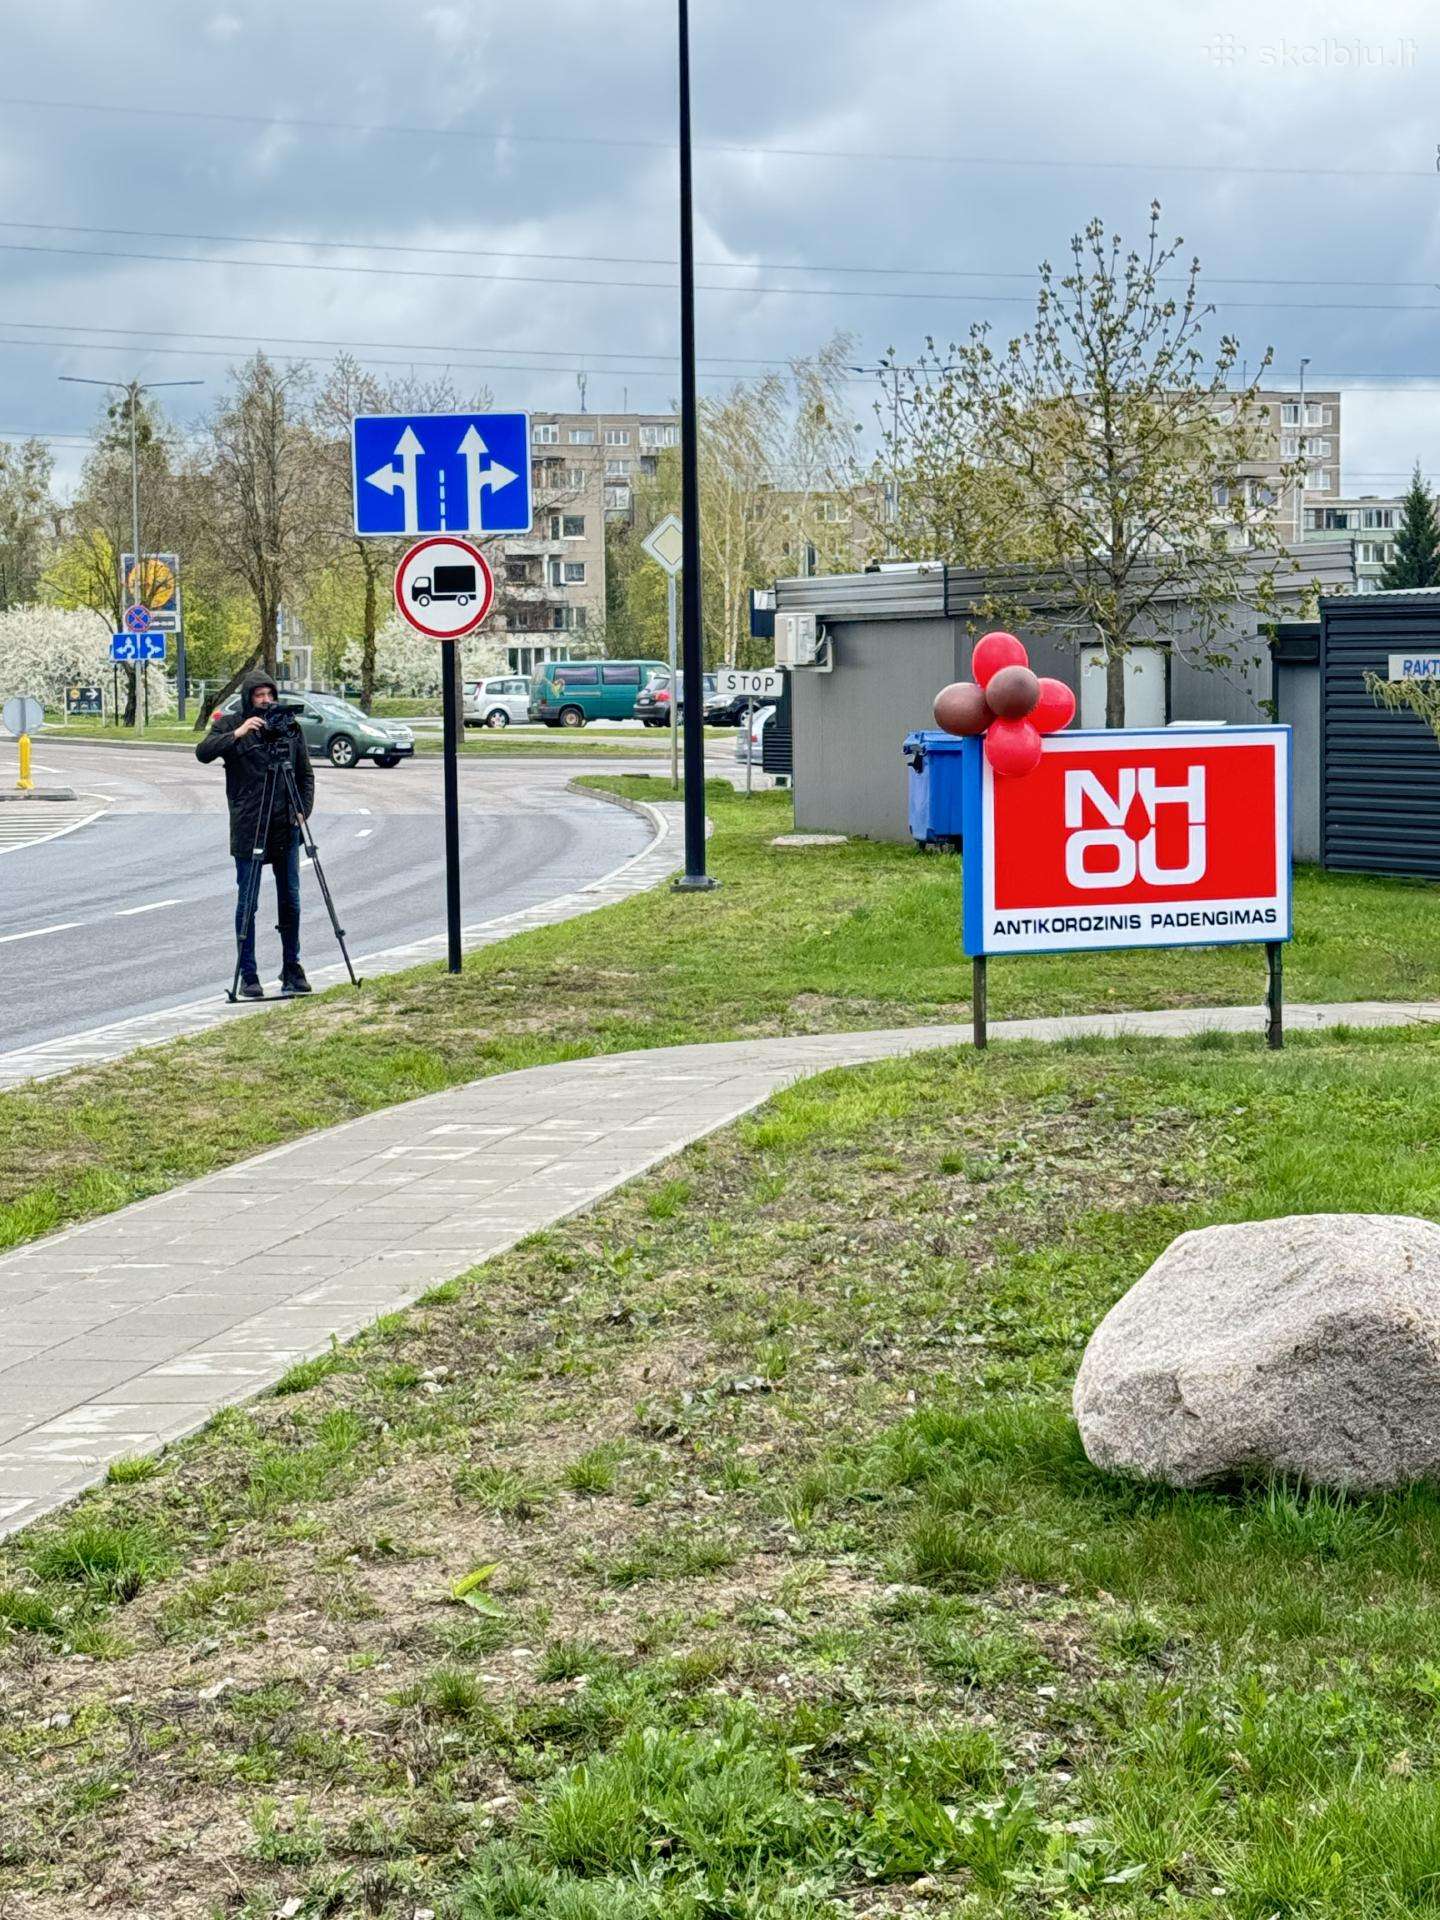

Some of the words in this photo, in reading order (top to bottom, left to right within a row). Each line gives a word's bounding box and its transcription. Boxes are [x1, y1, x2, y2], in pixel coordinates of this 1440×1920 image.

[1402, 659, 1440, 676] RAKT
[727, 674, 774, 692] STOP
[993, 914, 1142, 936] ANTIKOROZINIS
[1151, 908, 1277, 929] PADENGIMAS
